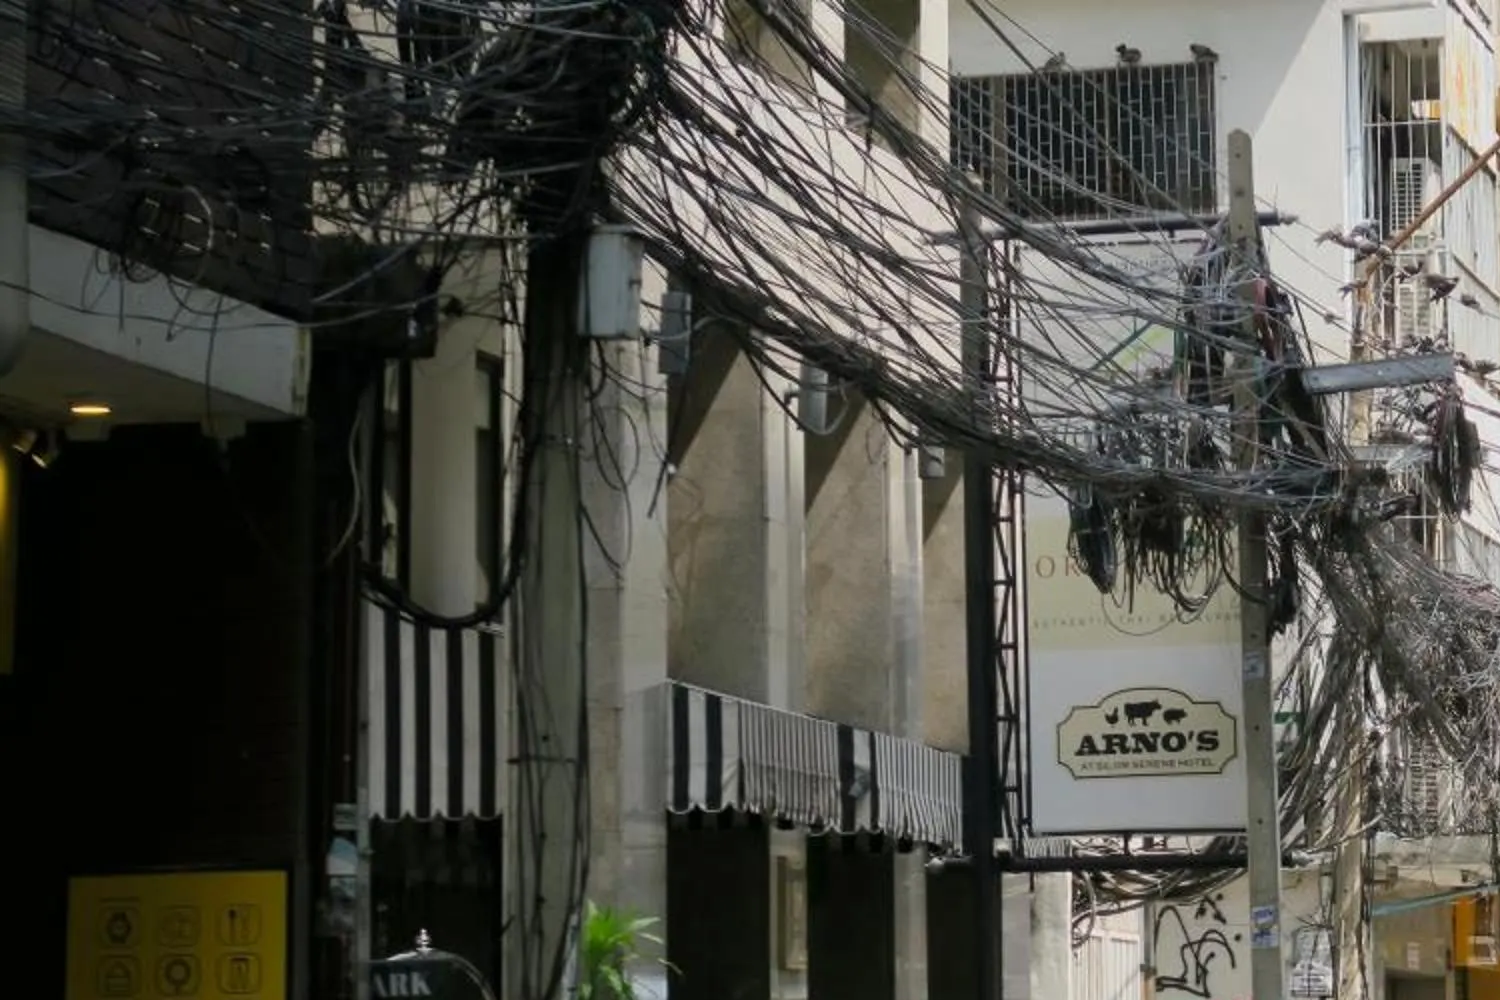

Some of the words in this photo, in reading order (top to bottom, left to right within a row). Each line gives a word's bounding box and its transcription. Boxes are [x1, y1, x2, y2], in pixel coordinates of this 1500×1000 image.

[1074, 730, 1219, 756] ARNO'S
[1177, 757, 1216, 768] HOTEL
[373, 971, 432, 999] ARK
